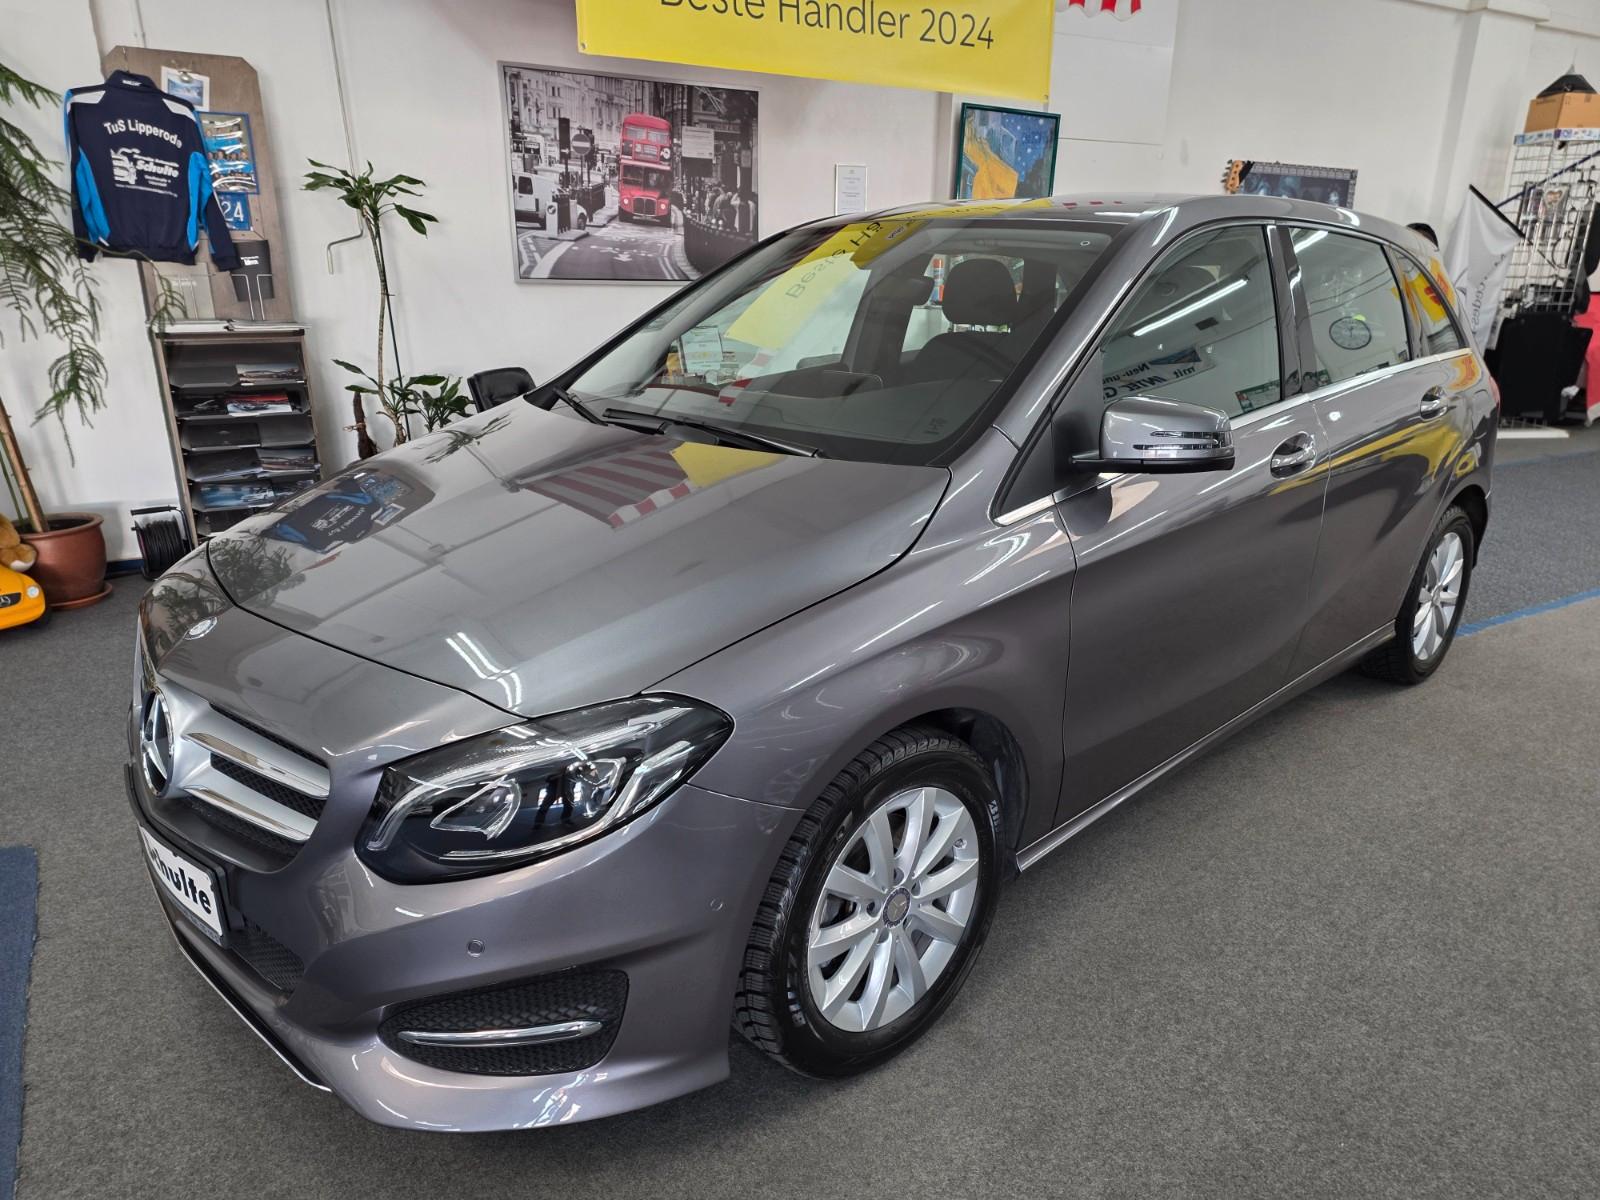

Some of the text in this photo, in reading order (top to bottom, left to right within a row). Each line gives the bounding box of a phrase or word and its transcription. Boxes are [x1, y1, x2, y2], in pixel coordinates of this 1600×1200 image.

[919, 8, 994, 50] 2024
[103, 119, 183, 149] TuS Lipperode
